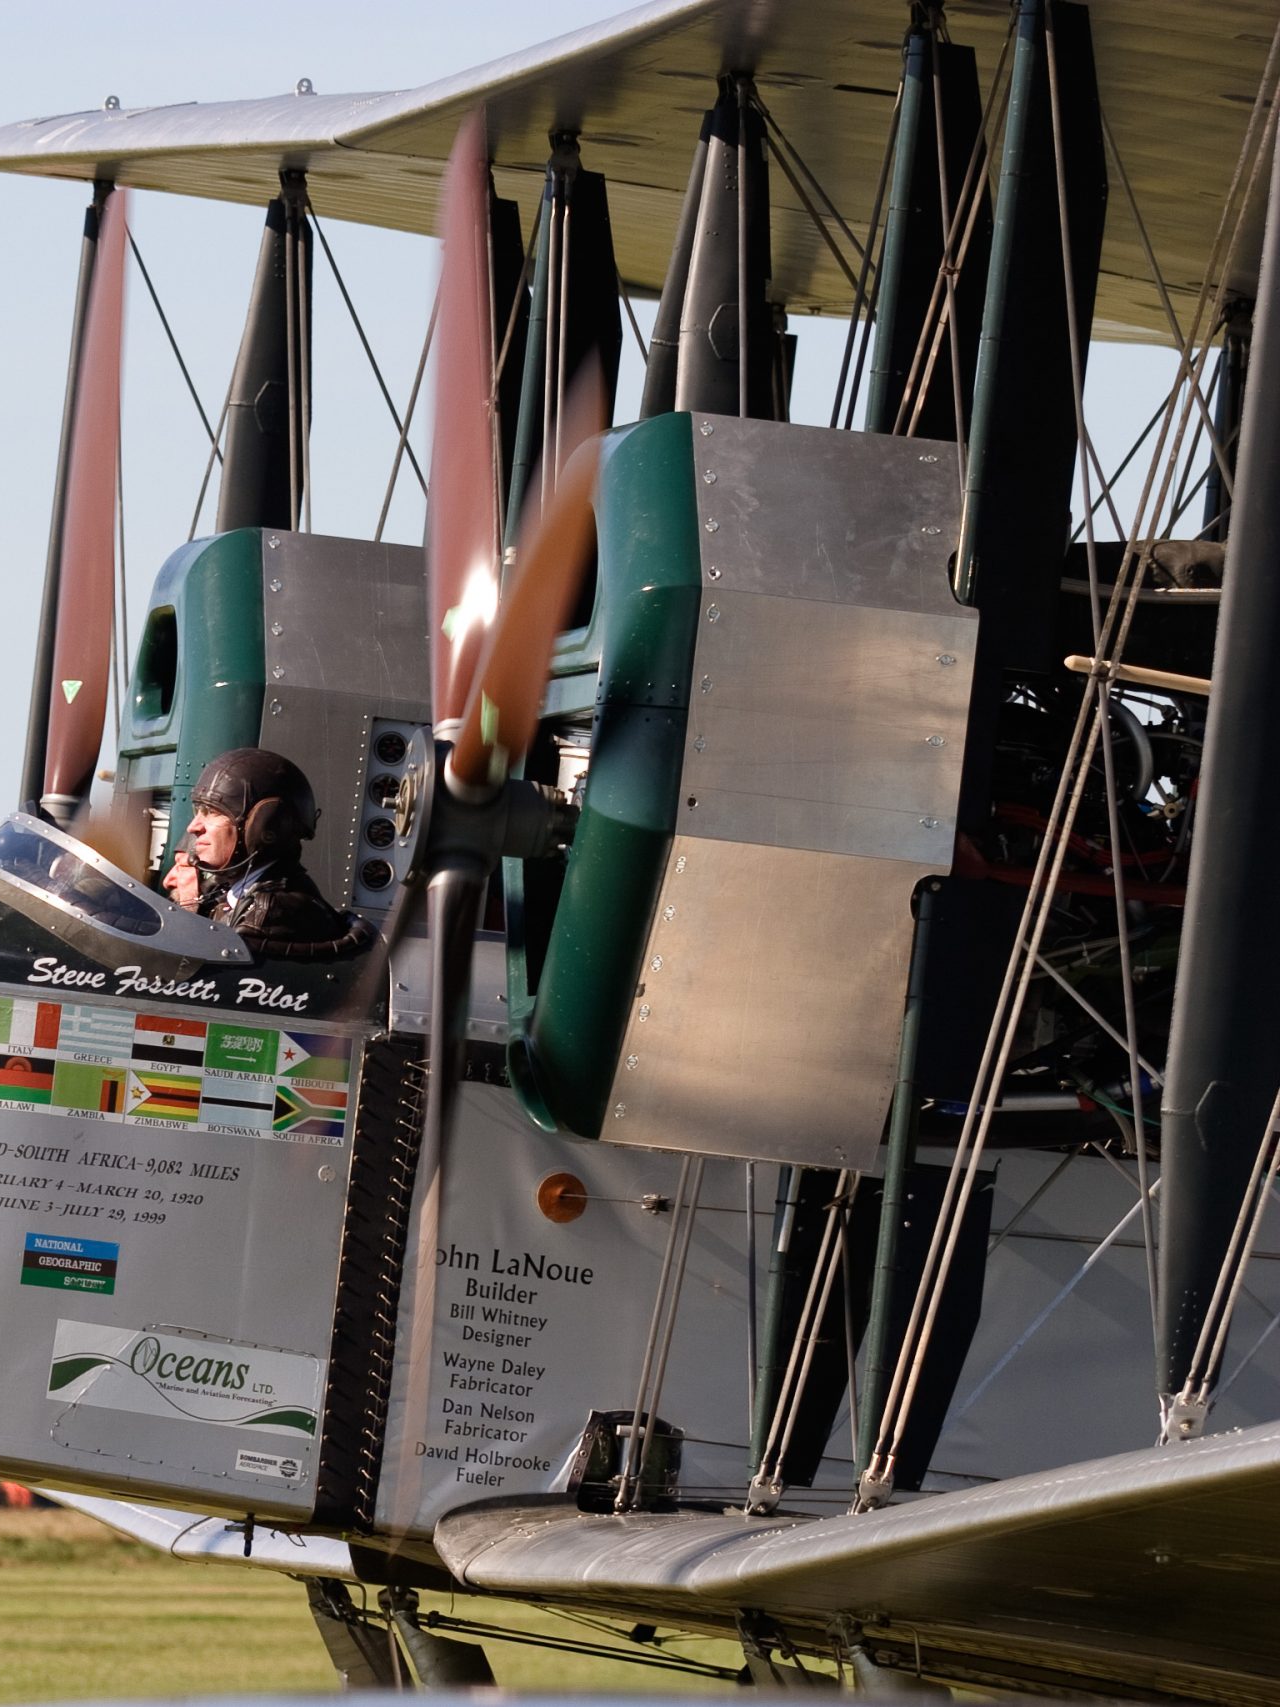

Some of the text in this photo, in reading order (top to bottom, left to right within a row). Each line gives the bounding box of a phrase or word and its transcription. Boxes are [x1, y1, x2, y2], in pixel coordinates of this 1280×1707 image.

[27, 957, 309, 1011] Steve Fossett, Pilot
[7, 1045, 34, 1055] ITALY
[73, 1053, 112, 1064] GREECE
[150, 1062, 182, 1073] EGYPT
[204, 1068, 273, 1083] SAUDI ARABIA
[67, 1109, 105, 1120] ZAMBIA
[134, 1117, 189, 1130] ZIMBABWE
[207, 1124, 261, 1137] BOTSWANA
[272, 1132, 342, 1146] SOUTH AFRICA
[189, 1163, 240, 1181] MILES
[144, 1189, 164, 1203] 20,
[170, 1193, 204, 1206] 1920
[108, 1209, 126, 1223] 29,
[132, 1212, 166, 1225] 1999
[34, 1238, 84, 1252] NATIONAL
[38, 1256, 102, 1272] GEOGRAPHIC
[420, 1244, 594, 1285] ohn LaNoue
[465, 1278, 538, 1304] Builder
[450, 1303, 548, 1331] Bill Whitney
[462, 1325, 532, 1348] Designer
[131, 1336, 276, 1395] Oceans LTD.
[443, 1351, 546, 1381] Wayne Daley
[185, 1387, 199, 1395] and
[201, 1389, 230, 1400] Aviation
[449, 1373, 533, 1398] Fabricator
[442, 1398, 535, 1423] Dan Nelson
[444, 1419, 528, 1443] Fabricator
[415, 1441, 551, 1471] David Holbrooke
[456, 1467, 505, 1487] Fueler
